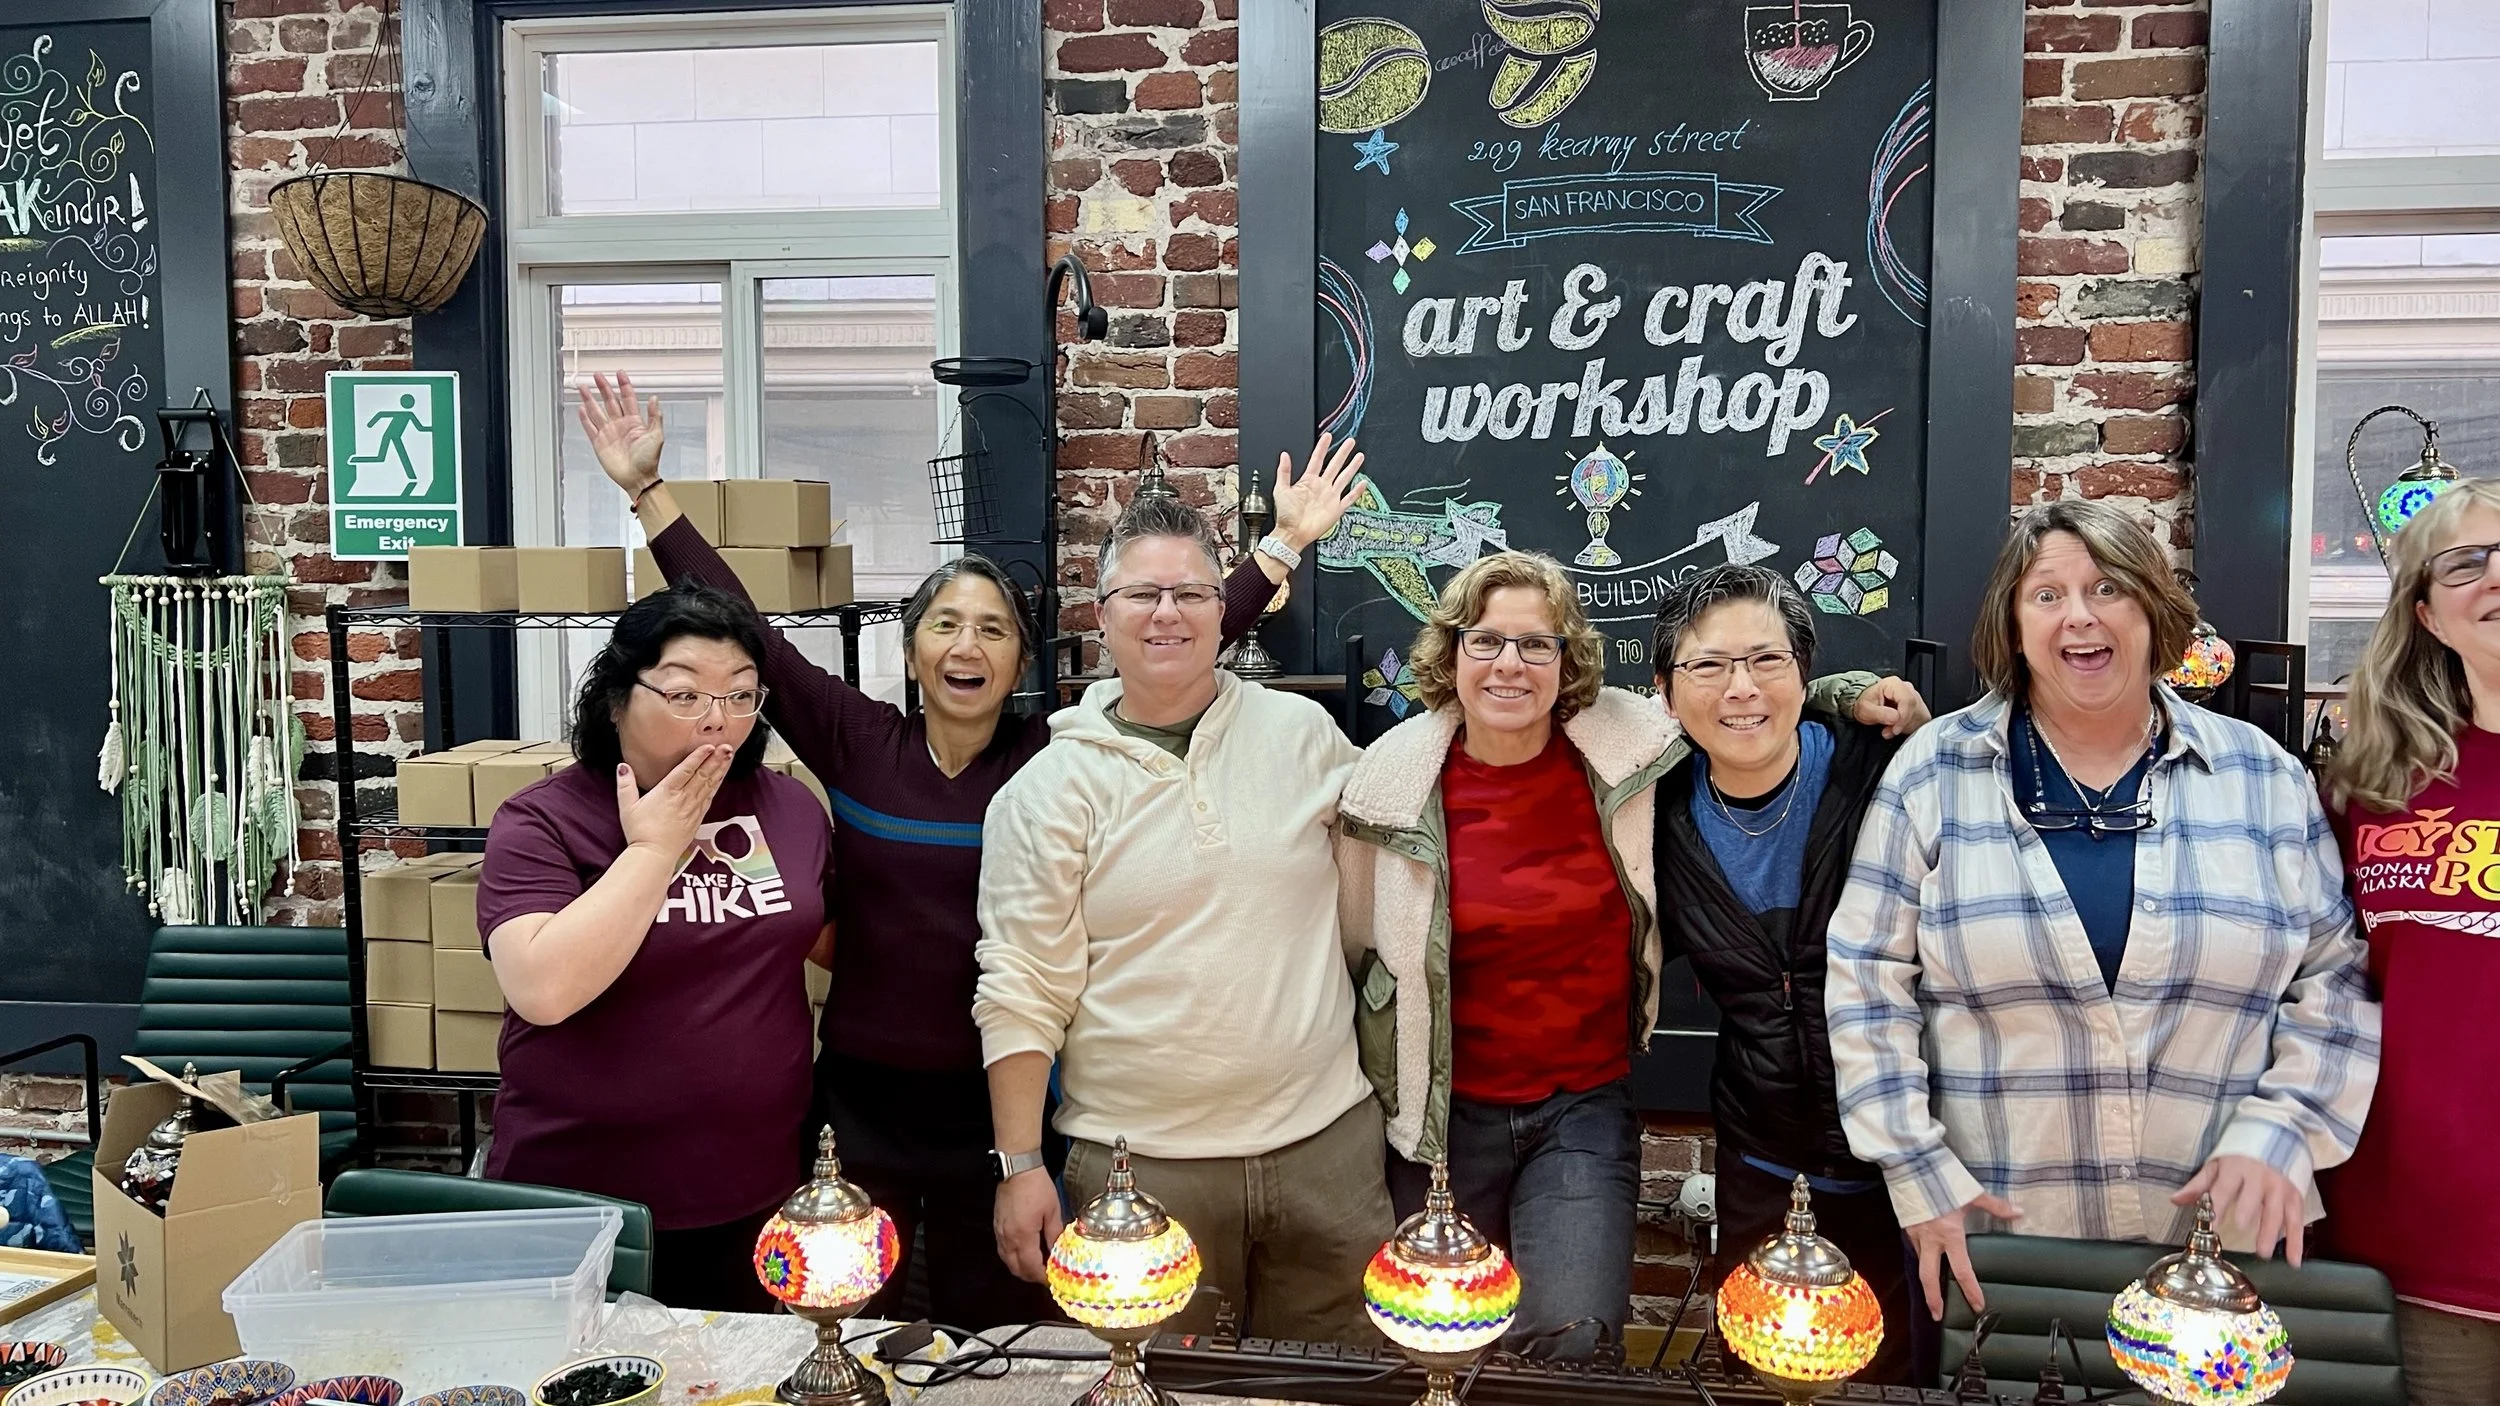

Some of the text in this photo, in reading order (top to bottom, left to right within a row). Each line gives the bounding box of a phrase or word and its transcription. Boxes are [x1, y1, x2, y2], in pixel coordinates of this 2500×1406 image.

[1538, 123, 1638, 174] kearny
[1648, 119, 1751, 156] street
[1514, 188, 1704, 219] SAN FRANCISCO
[43, 306, 62, 326] to
[73, 294, 150, 330] ALLAH!
[1402, 251, 1858, 367] art & craft
[1420, 354, 1830, 457] workshop
[344, 515, 449, 532] Emergency
[378, 536, 416, 551] Exit
[1616, 639, 1643, 664] 10
[2360, 825, 2446, 857] ICY
[681, 873, 746, 888] TAKE A
[2361, 876, 2426, 895] ALASKA
[656, 878, 793, 923] HIKE
